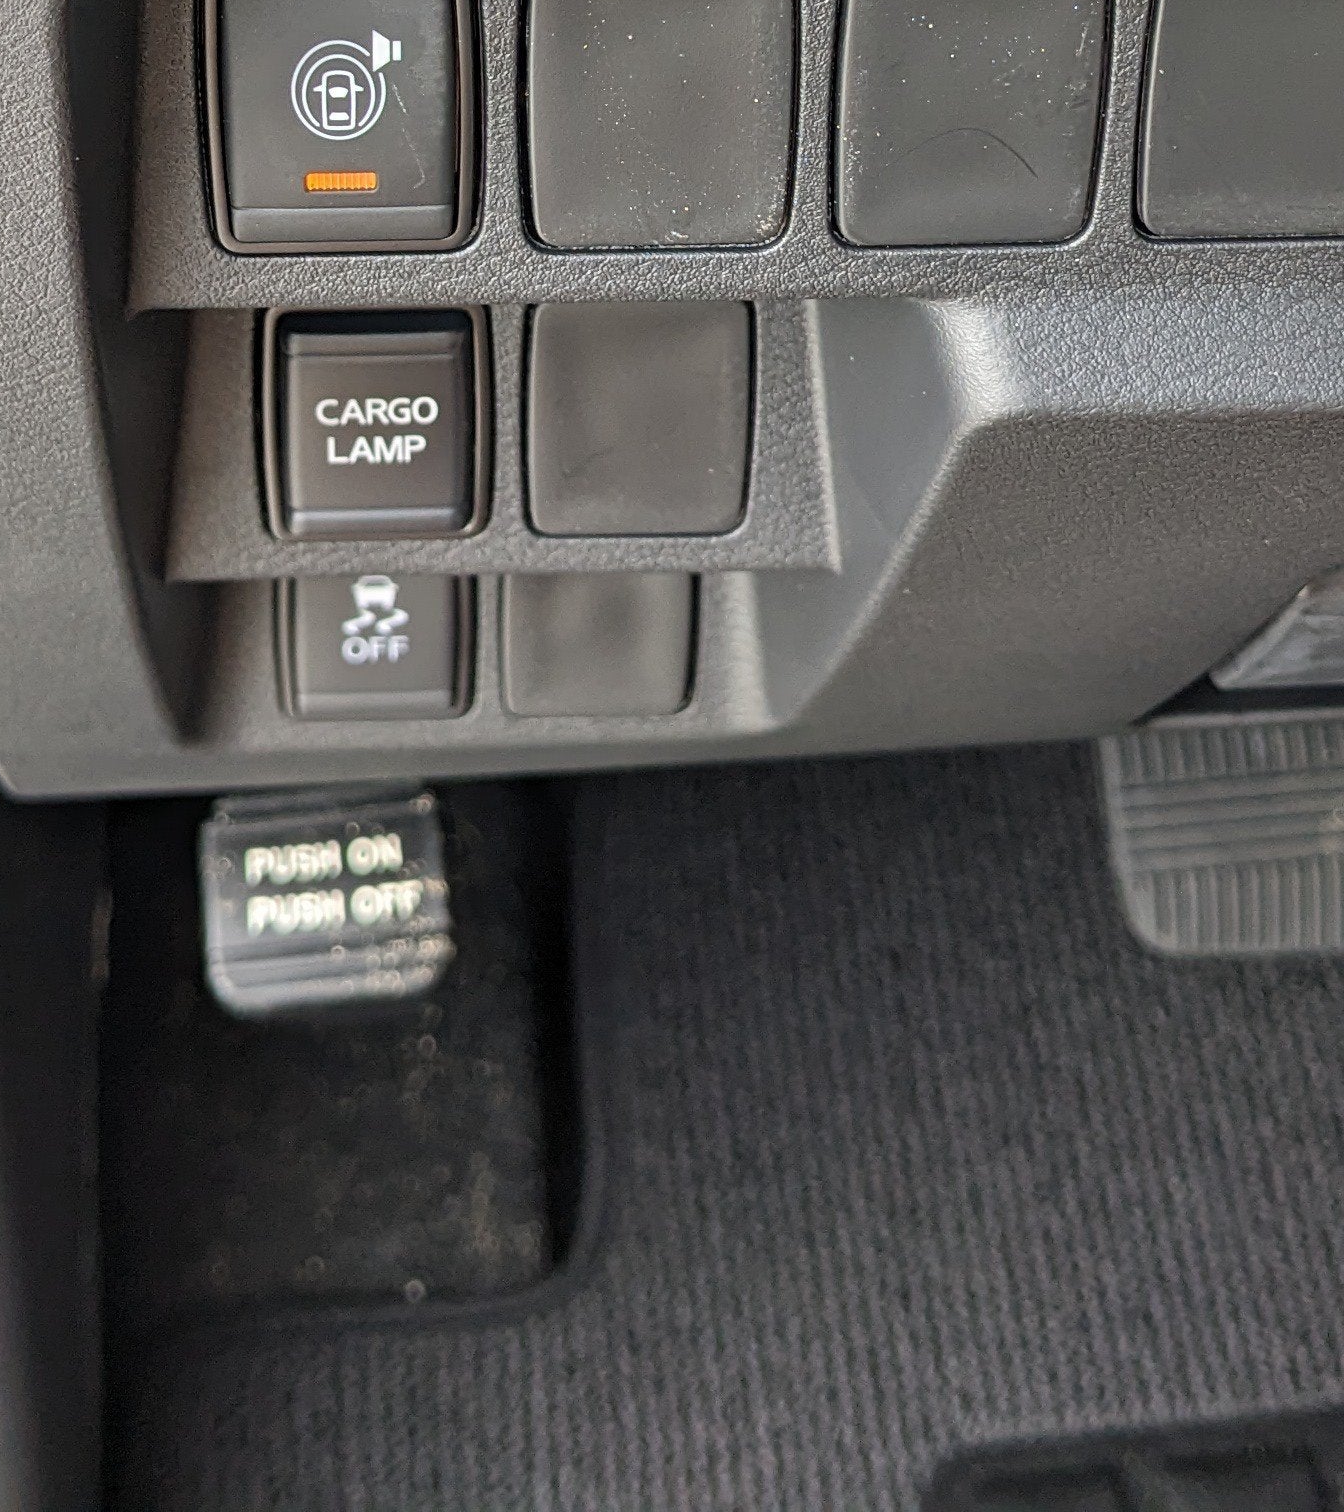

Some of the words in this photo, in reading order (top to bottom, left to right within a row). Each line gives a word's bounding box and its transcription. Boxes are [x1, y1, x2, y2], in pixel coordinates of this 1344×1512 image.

[314, 396, 440, 427] CARGO
[326, 434, 428, 465] LAMP
[341, 635, 410, 666] OFF
[244, 839, 343, 887] PUSH
[346, 832, 404, 876] ON
[246, 888, 347, 937] PUSH
[350, 879, 424, 926] OFF
